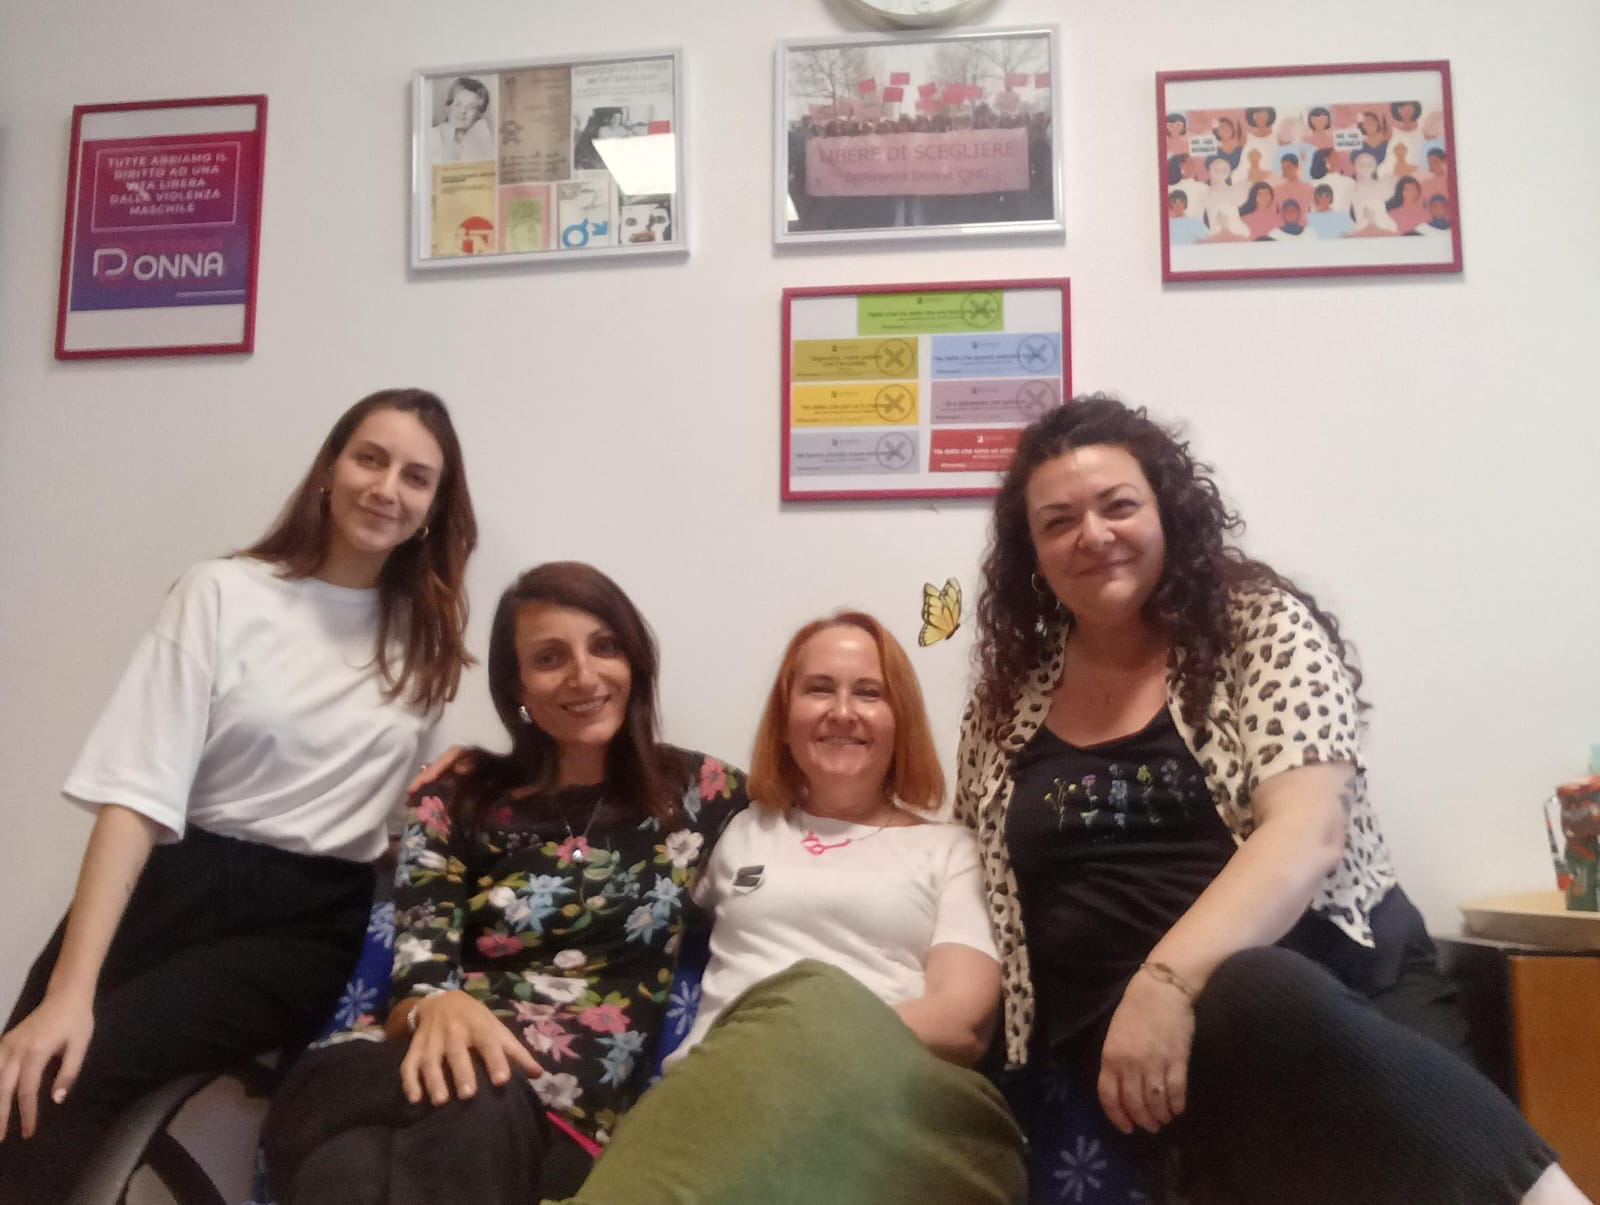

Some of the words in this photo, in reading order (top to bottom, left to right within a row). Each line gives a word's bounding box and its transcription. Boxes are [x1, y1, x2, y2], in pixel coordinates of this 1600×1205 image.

[887, 145, 907, 161] DI
[913, 142, 1017, 160] SCEGLIERE
[108, 156, 147, 168] TUTTE
[150, 153, 212, 166] ABBIAMO
[215, 152, 227, 163] IL
[113, 167, 166, 180] DIRITTO
[169, 166, 189, 177] AD
[191, 164, 220, 175] UNA
[159, 177, 207, 190] LIBERA
[156, 188, 221, 202] VIOLENZA
[129, 202, 195, 215] MASCHILE
[92, 248, 224, 280] DONNA
